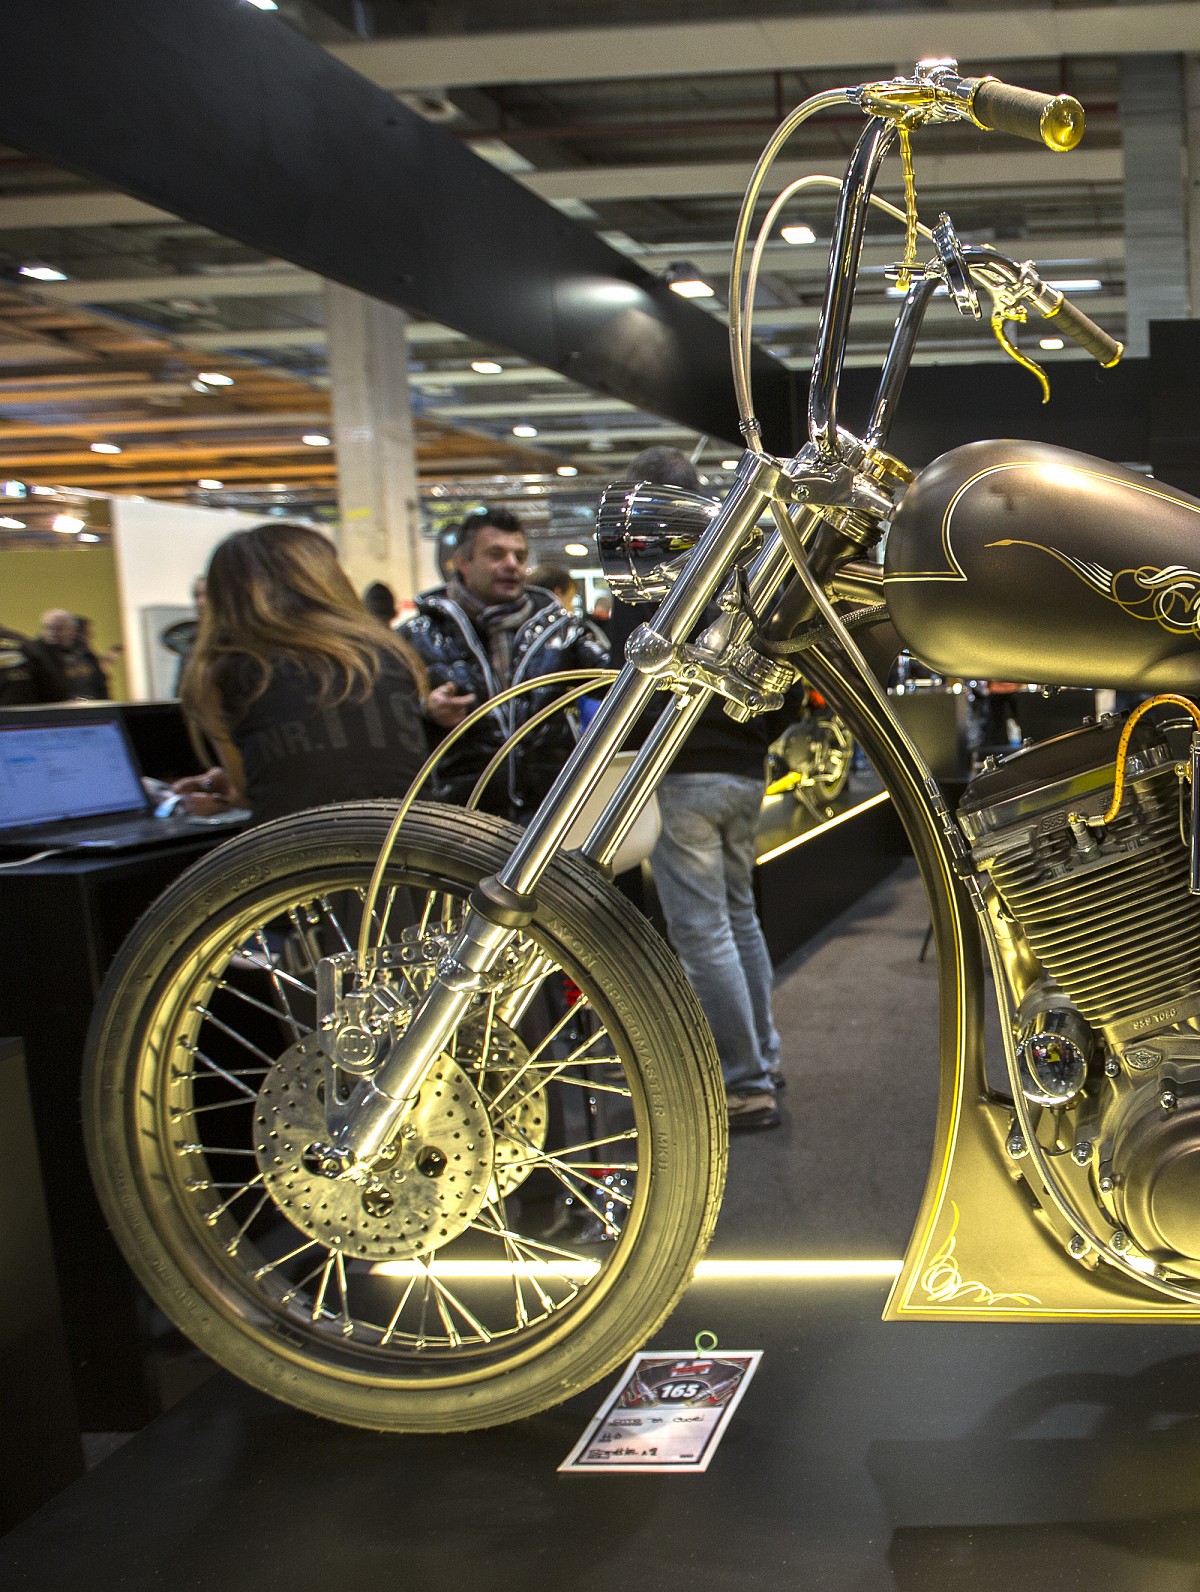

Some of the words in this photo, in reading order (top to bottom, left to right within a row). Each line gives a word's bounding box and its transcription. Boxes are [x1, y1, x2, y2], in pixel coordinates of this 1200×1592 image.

[1041, 814, 1065, 833] S&S
[546, 919, 598, 969] AVON
[602, 976, 666, 1118] SPEEDMASTER
[661, 1384, 699, 1398] 165
